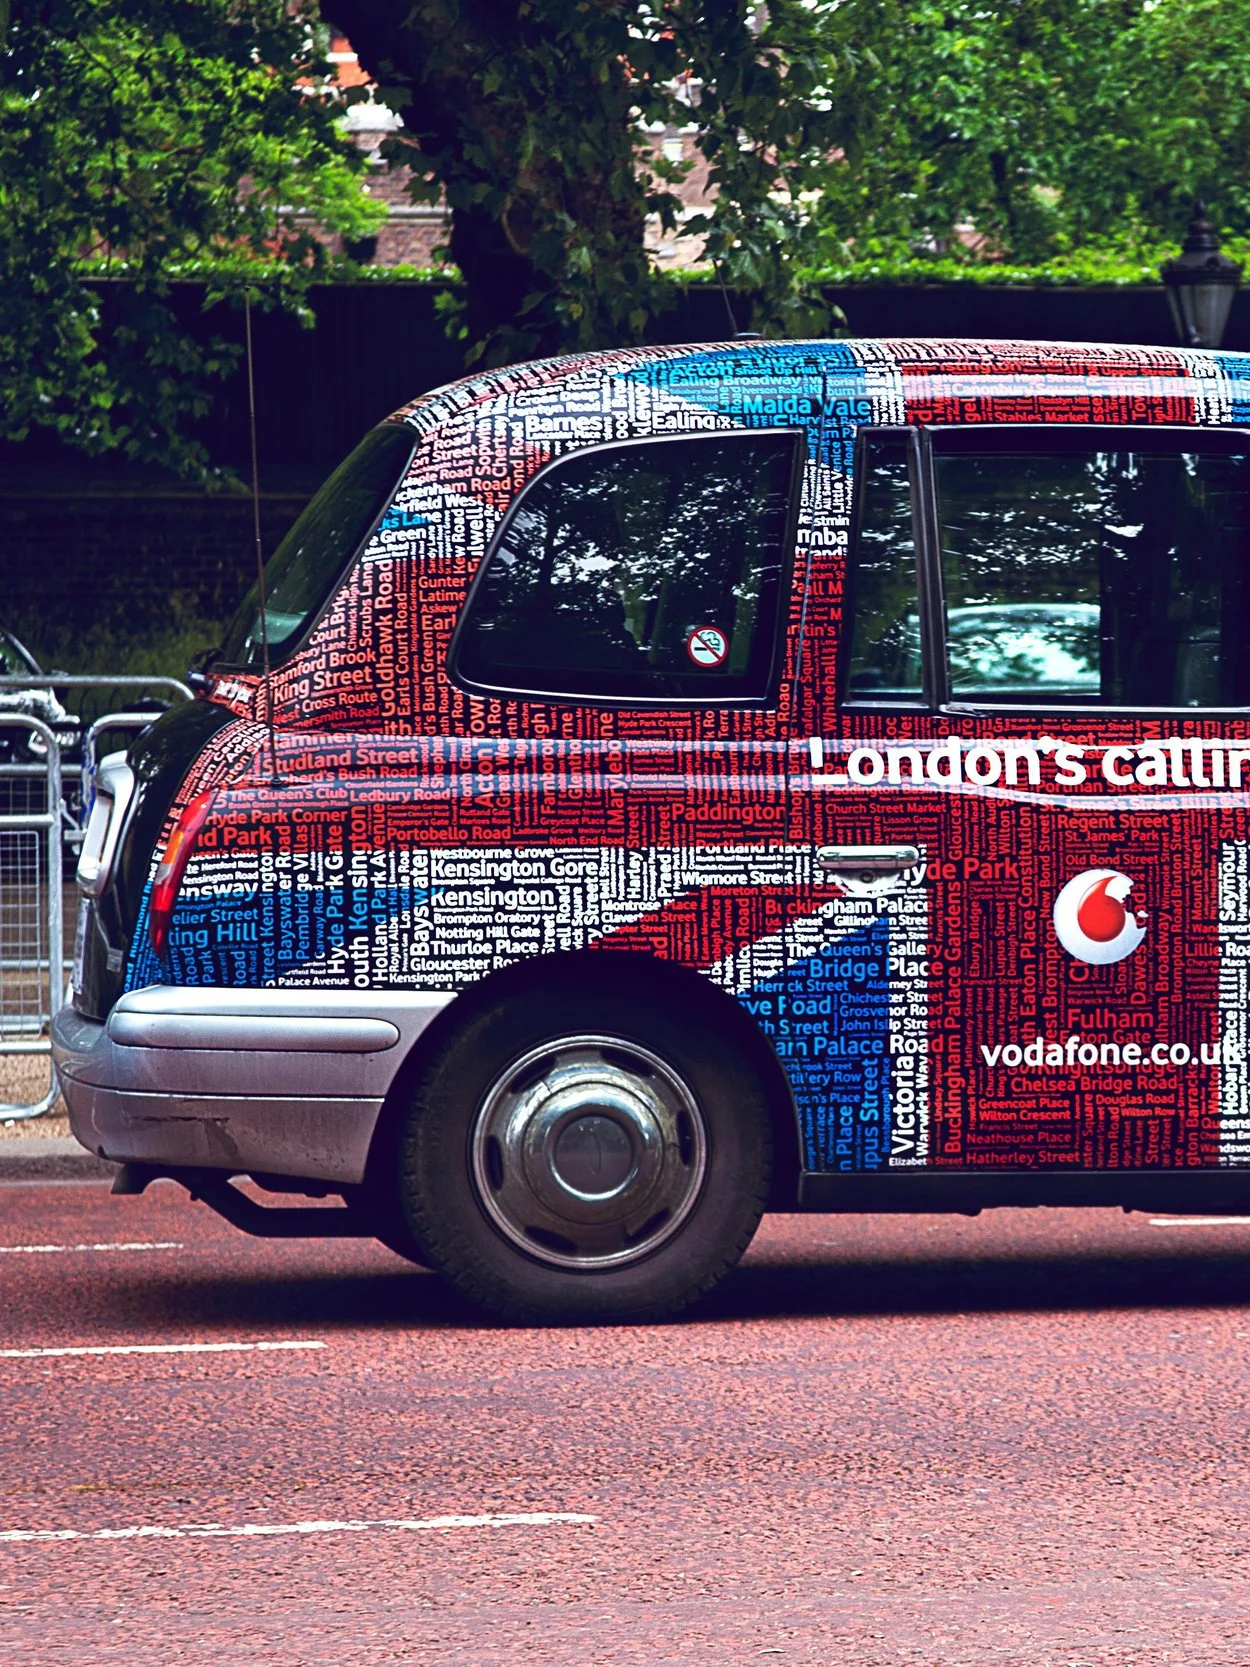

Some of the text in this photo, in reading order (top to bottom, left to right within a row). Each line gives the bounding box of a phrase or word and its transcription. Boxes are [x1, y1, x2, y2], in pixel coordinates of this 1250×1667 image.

[669, 376, 801, 387] Ealing Broadway
[744, 395, 871, 416] Maida Vale
[526, 416, 602, 433] Barnes
[1045, 412, 1088, 423] Market
[395, 593, 407, 629] Road
[375, 560, 395, 717] Goldhawk Road
[330, 650, 376, 667] Brook
[396, 633, 409, 674] Court
[273, 667, 373, 704] King Street
[823, 654, 837, 732] Whitehall
[356, 749, 418, 766] Street
[809, 736, 1086, 785] London's
[230, 788, 348, 802] The Queen's Club
[350, 788, 450, 804] Ledbury Road
[251, 808, 348, 824] Park Corner
[672, 803, 786, 823] Paddington
[825, 803, 947, 814] Church Street Market
[1057, 814, 1169, 832] Regent Street
[223, 827, 272, 846] Park
[387, 826, 511, 841] Portobello Road
[1065, 832, 1082, 841] St.
[1131, 831, 1159, 841] Park
[515, 848, 555, 859] Grove
[1018, 806, 1032, 907] Constitution
[1065, 854, 1159, 865] Old Bond Street
[430, 858, 598, 882] Kensington Gore
[963, 858, 1018, 880] Park
[681, 871, 794, 888] Wigmore Street
[410, 849, 434, 956] Bayswater
[431, 887, 554, 911] Kensington
[210, 909, 258, 922] Street
[434, 912, 541, 925] Brompton Oratory
[216, 924, 258, 943] Hill
[435, 926, 540, 941] Notting Hill Gate
[430, 941, 539, 955] Thurloe Place
[787, 942, 942, 957] The Queen's Gallery
[410, 957, 490, 972] Gloucester
[809, 957, 944, 981] Bridge Place
[1131, 945, 1147, 1006] Dawes
[1020, 964, 1036, 1016] Eaton
[944, 881, 964, 1153] Buckingham Palace Gardens
[1067, 1008, 1154, 1029] Fulham
[813, 1037, 884, 1055] Palace
[890, 1034, 944, 1054] Road
[1113, 1030, 1151, 1044] Gate
[980, 1036, 1243, 1066] vodafone.co.uk
[1010, 1076, 1177, 1094] Chelsea Bridge Road
[891, 1055, 916, 1155] Victoria
[979, 1099, 1070, 1109] Greencoat Place
[979, 1111, 1071, 1121] Wilton Crescent
[967, 1133, 1071, 1143] Neathouse Place
[966, 1152, 1081, 1165] Hatherley Street
